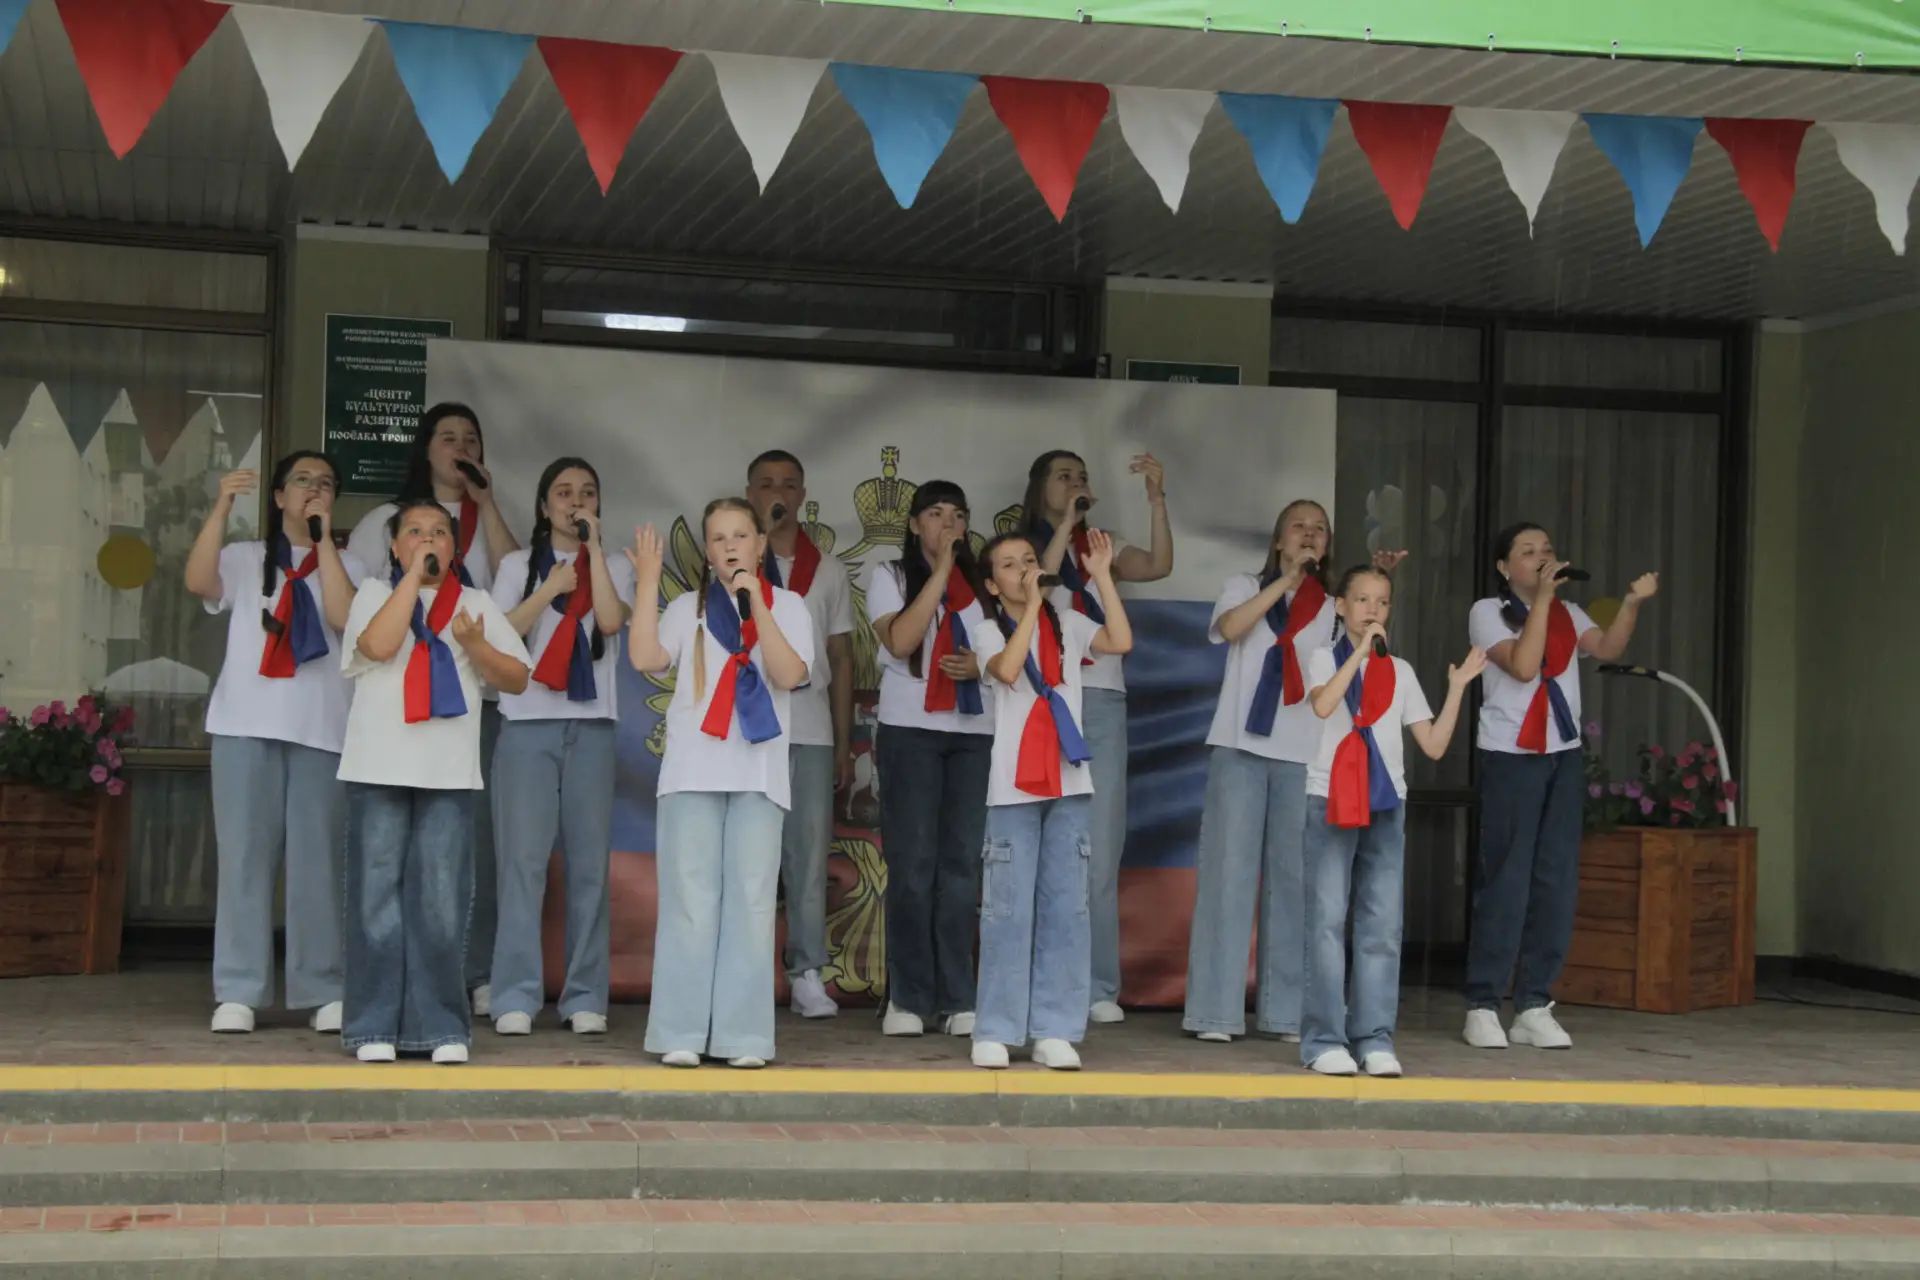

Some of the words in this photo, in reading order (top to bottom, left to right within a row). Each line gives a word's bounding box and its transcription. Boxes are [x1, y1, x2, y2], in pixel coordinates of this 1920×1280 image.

[355, 414, 419, 427] РАЗВИТИЯ
[329, 430, 378, 441] ПОСЁЛКА
[380, 433, 416, 443] ТРОИЦ
